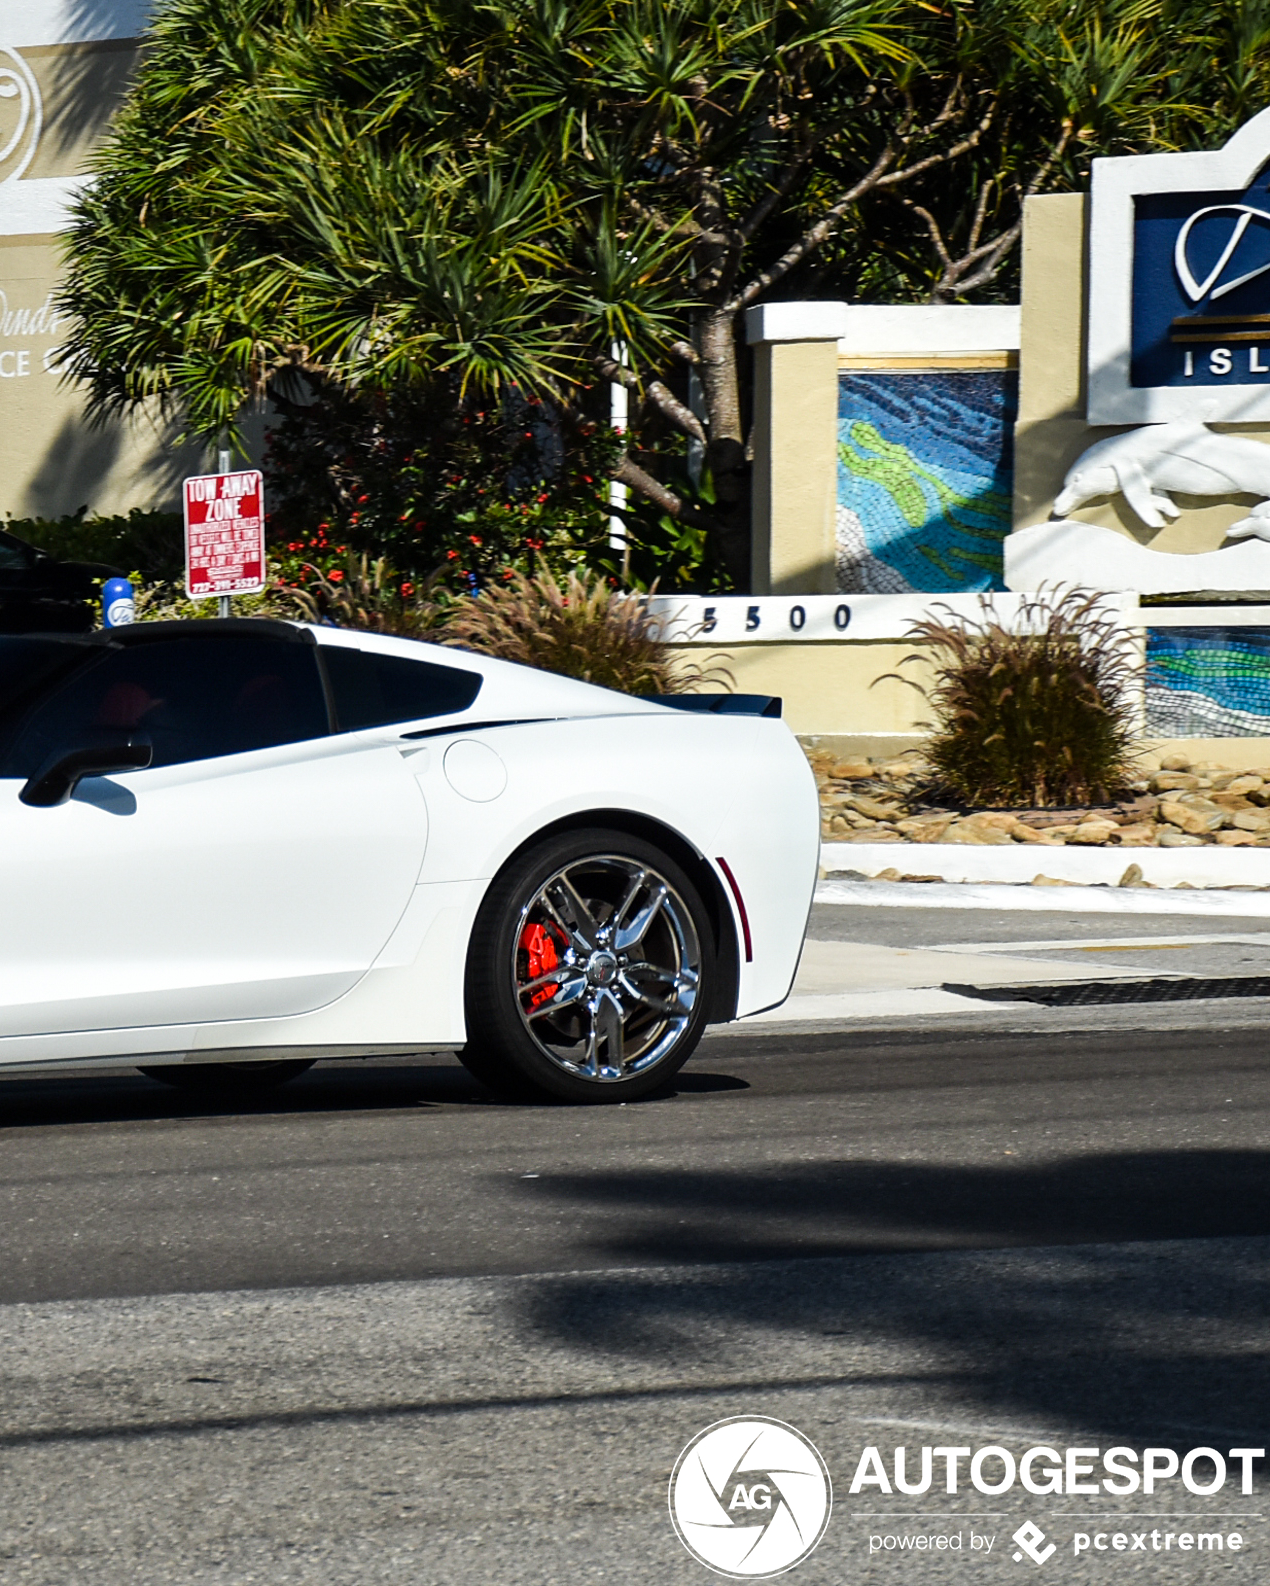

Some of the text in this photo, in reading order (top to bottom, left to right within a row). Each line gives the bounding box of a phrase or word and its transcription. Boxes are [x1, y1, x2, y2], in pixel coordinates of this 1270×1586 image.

[187, 474, 258, 502] TOW AWAY
[205, 497, 242, 522] ZONE
[702, 604, 851, 632] 5500
